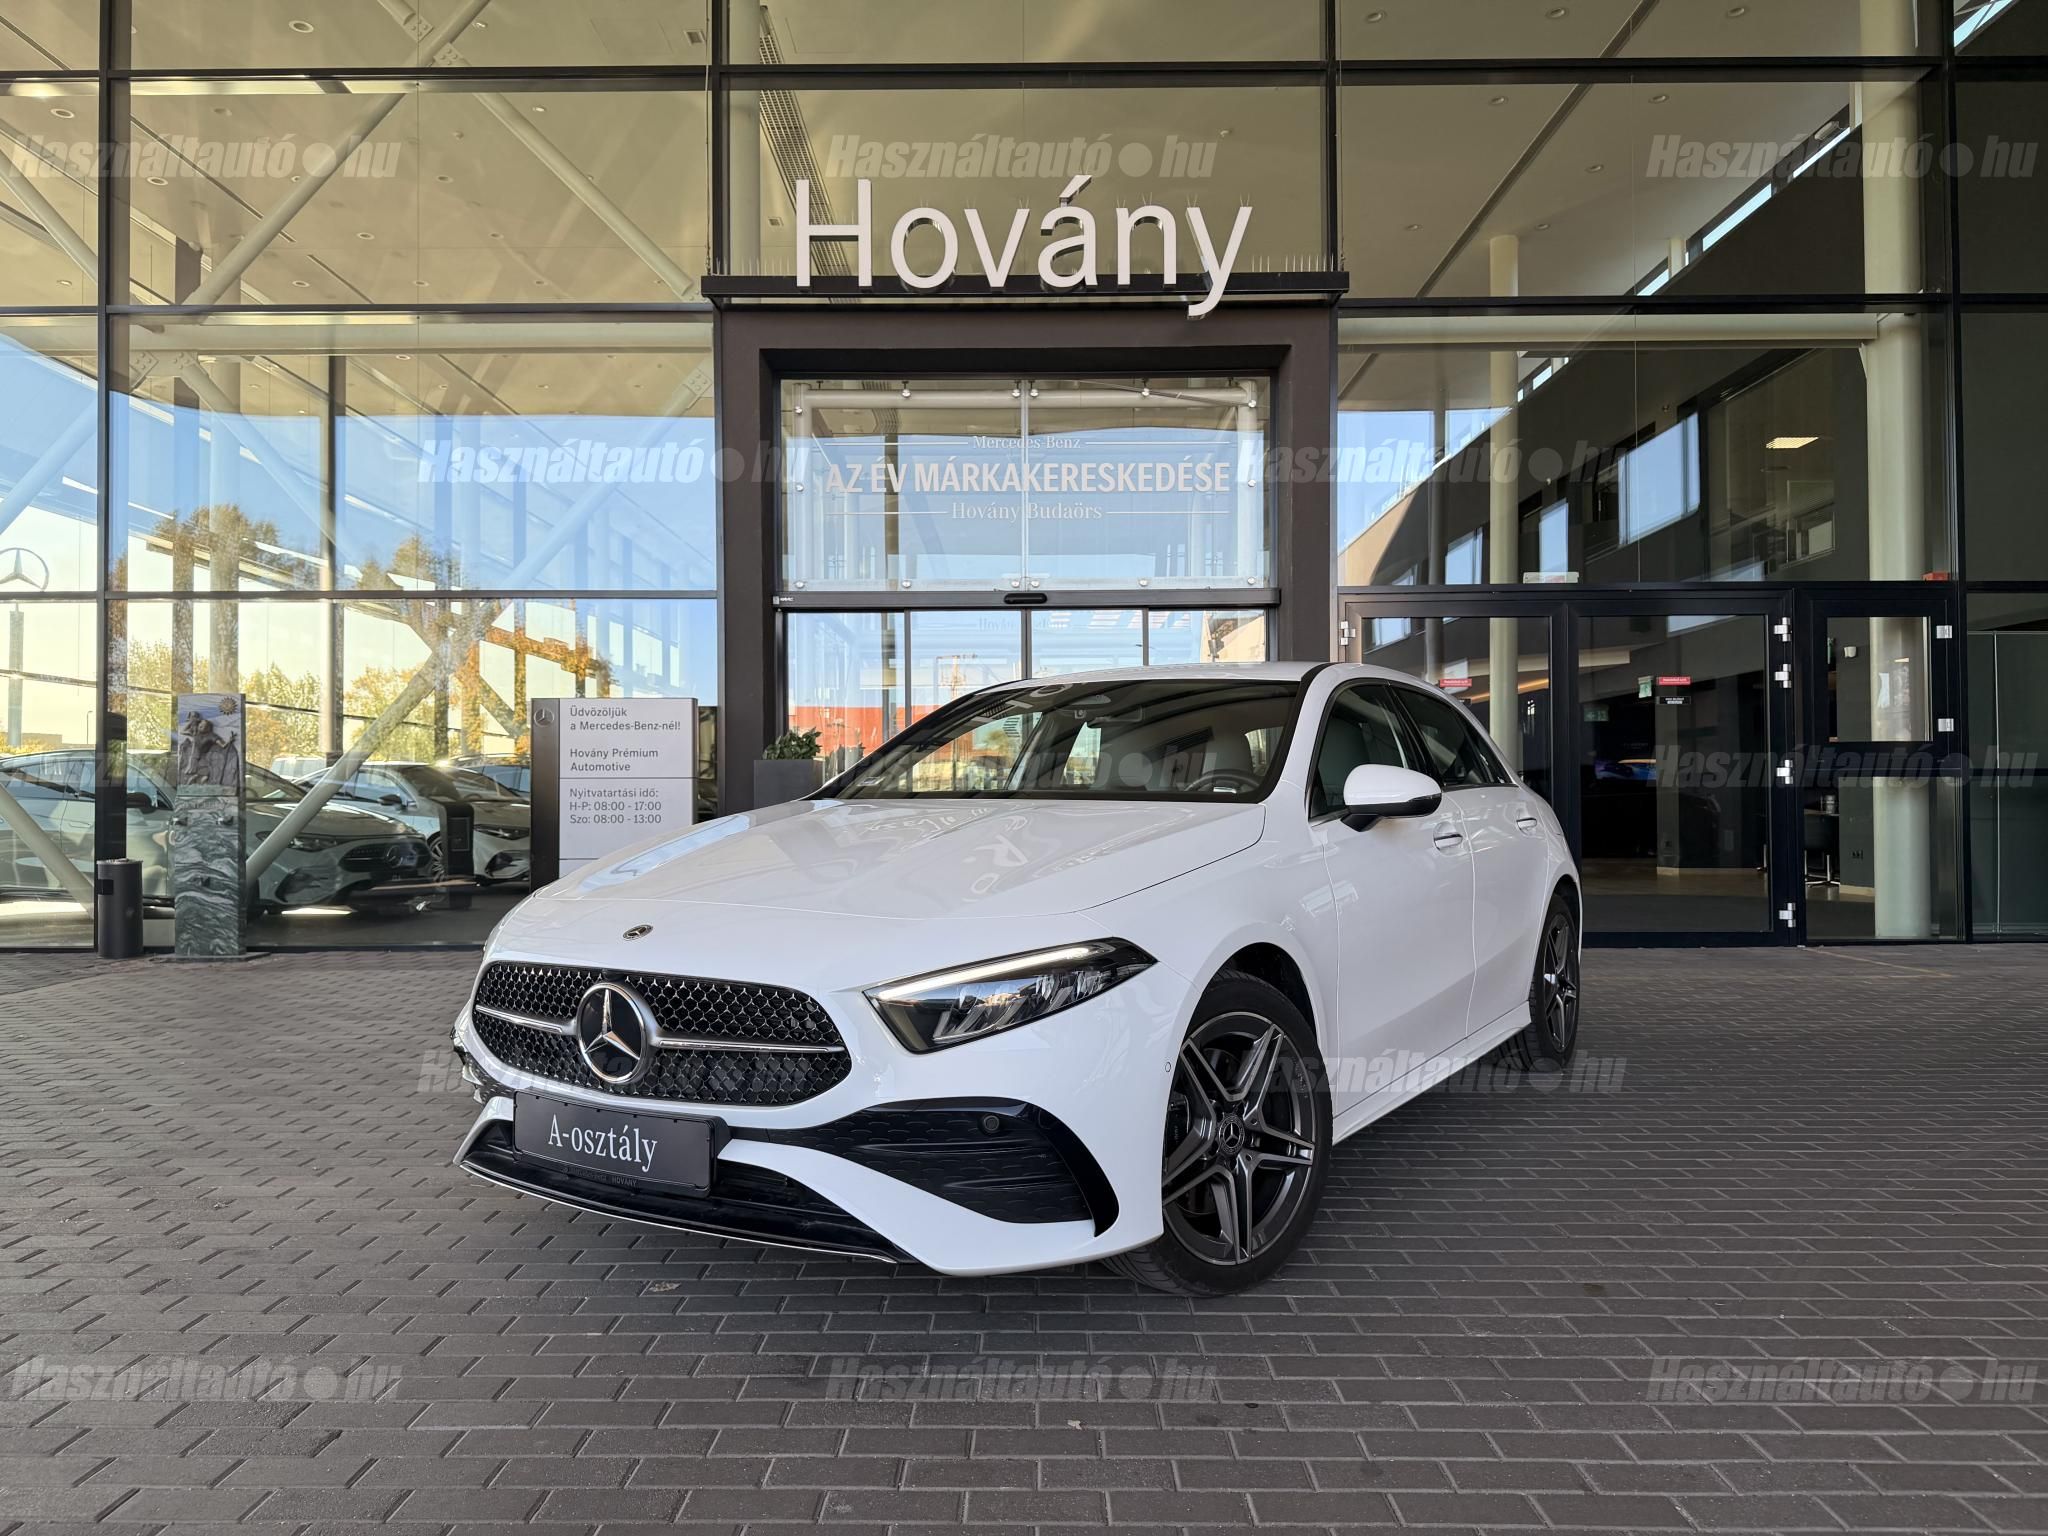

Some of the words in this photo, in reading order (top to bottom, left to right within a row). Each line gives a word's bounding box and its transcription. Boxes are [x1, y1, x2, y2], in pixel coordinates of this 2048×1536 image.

[795, 174, 1253, 318] Hovány
[972, 436, 1081, 449] Mercedes-Benz
[826, 463, 863, 493] AZ
[871, 456, 908, 493] ÉV
[914, 455, 1230, 493] MÁRKAKERESKEDÉSE
[952, 502, 1021, 523] Hovány
[1027, 503, 1103, 520] Budaörs
[569, 705, 628, 719] Üdvözöljük
[570, 723, 576, 731] a
[580, 721, 681, 731] Mercedes-Benz-nél!
[570, 748, 608, 760] Hovány
[612, 748, 659, 758] Prémium
[570, 762, 631, 772] Automotive
[569, 788, 637, 800] Nyitvatartási
[639, 788, 659, 798] idő:
[569, 802, 592, 811] H-P:
[593, 802, 625, 811] 08:00
[634, 802, 662, 811] 17:00
[569, 815, 591, 824] Szo:
[593, 815, 625, 824] 08:00
[633, 815, 662, 824] 13:00
[548, 1113, 658, 1173] A-osztály
